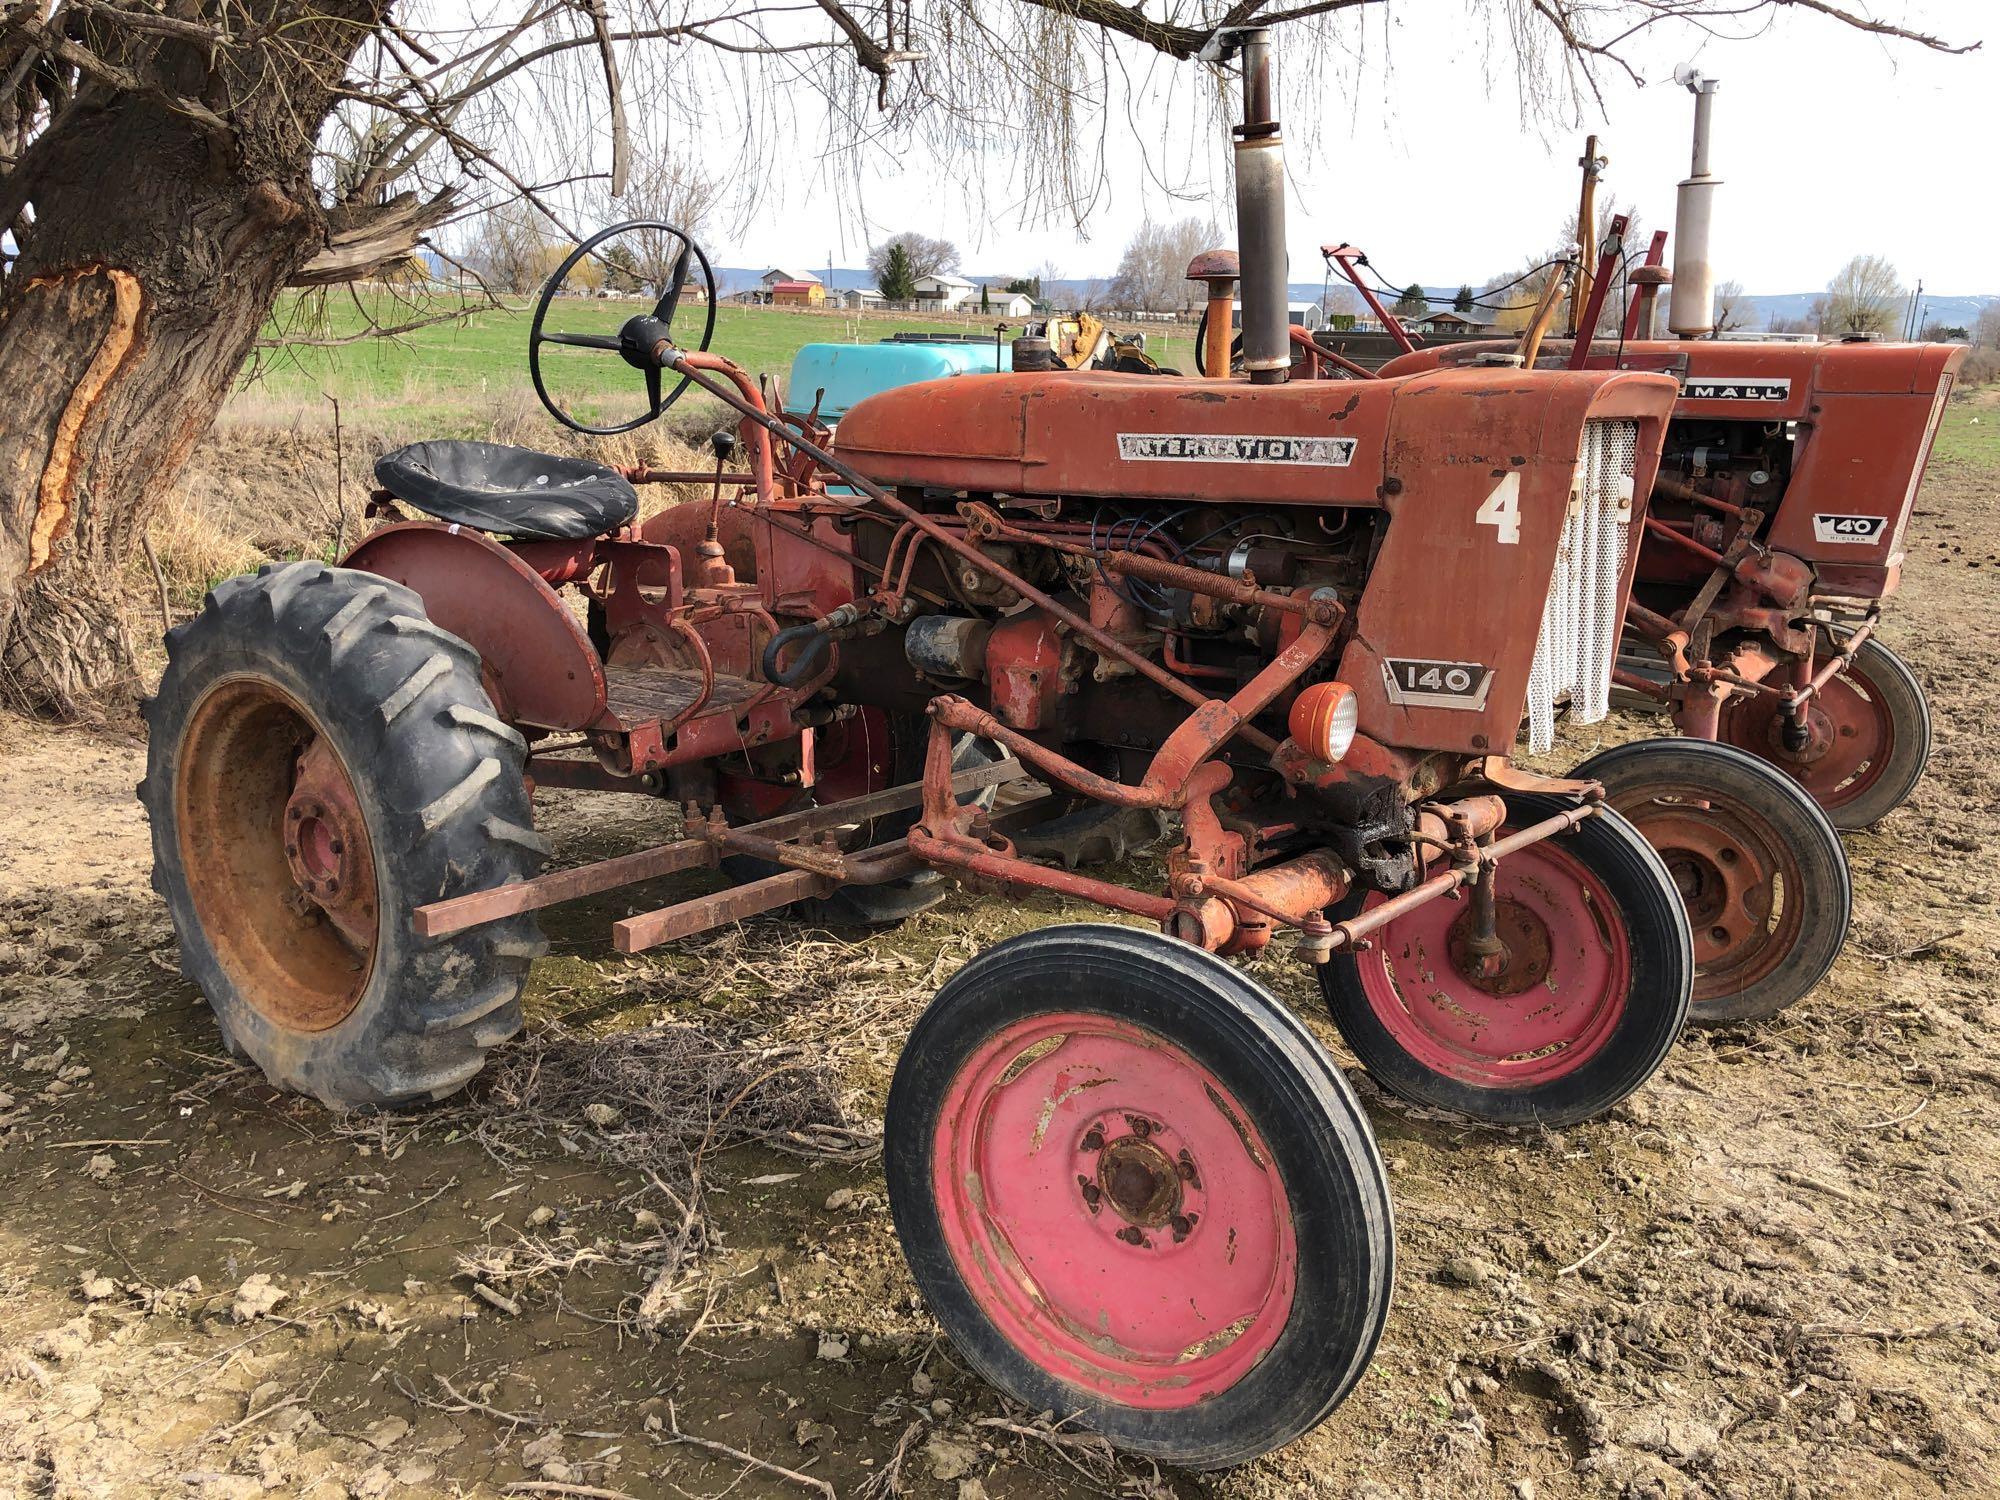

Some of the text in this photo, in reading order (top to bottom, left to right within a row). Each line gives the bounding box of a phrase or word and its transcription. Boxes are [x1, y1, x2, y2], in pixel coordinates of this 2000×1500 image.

[1476, 472, 1521, 544] 4
[1829, 518, 1871, 534] 140
[1407, 666, 1471, 692] 140
